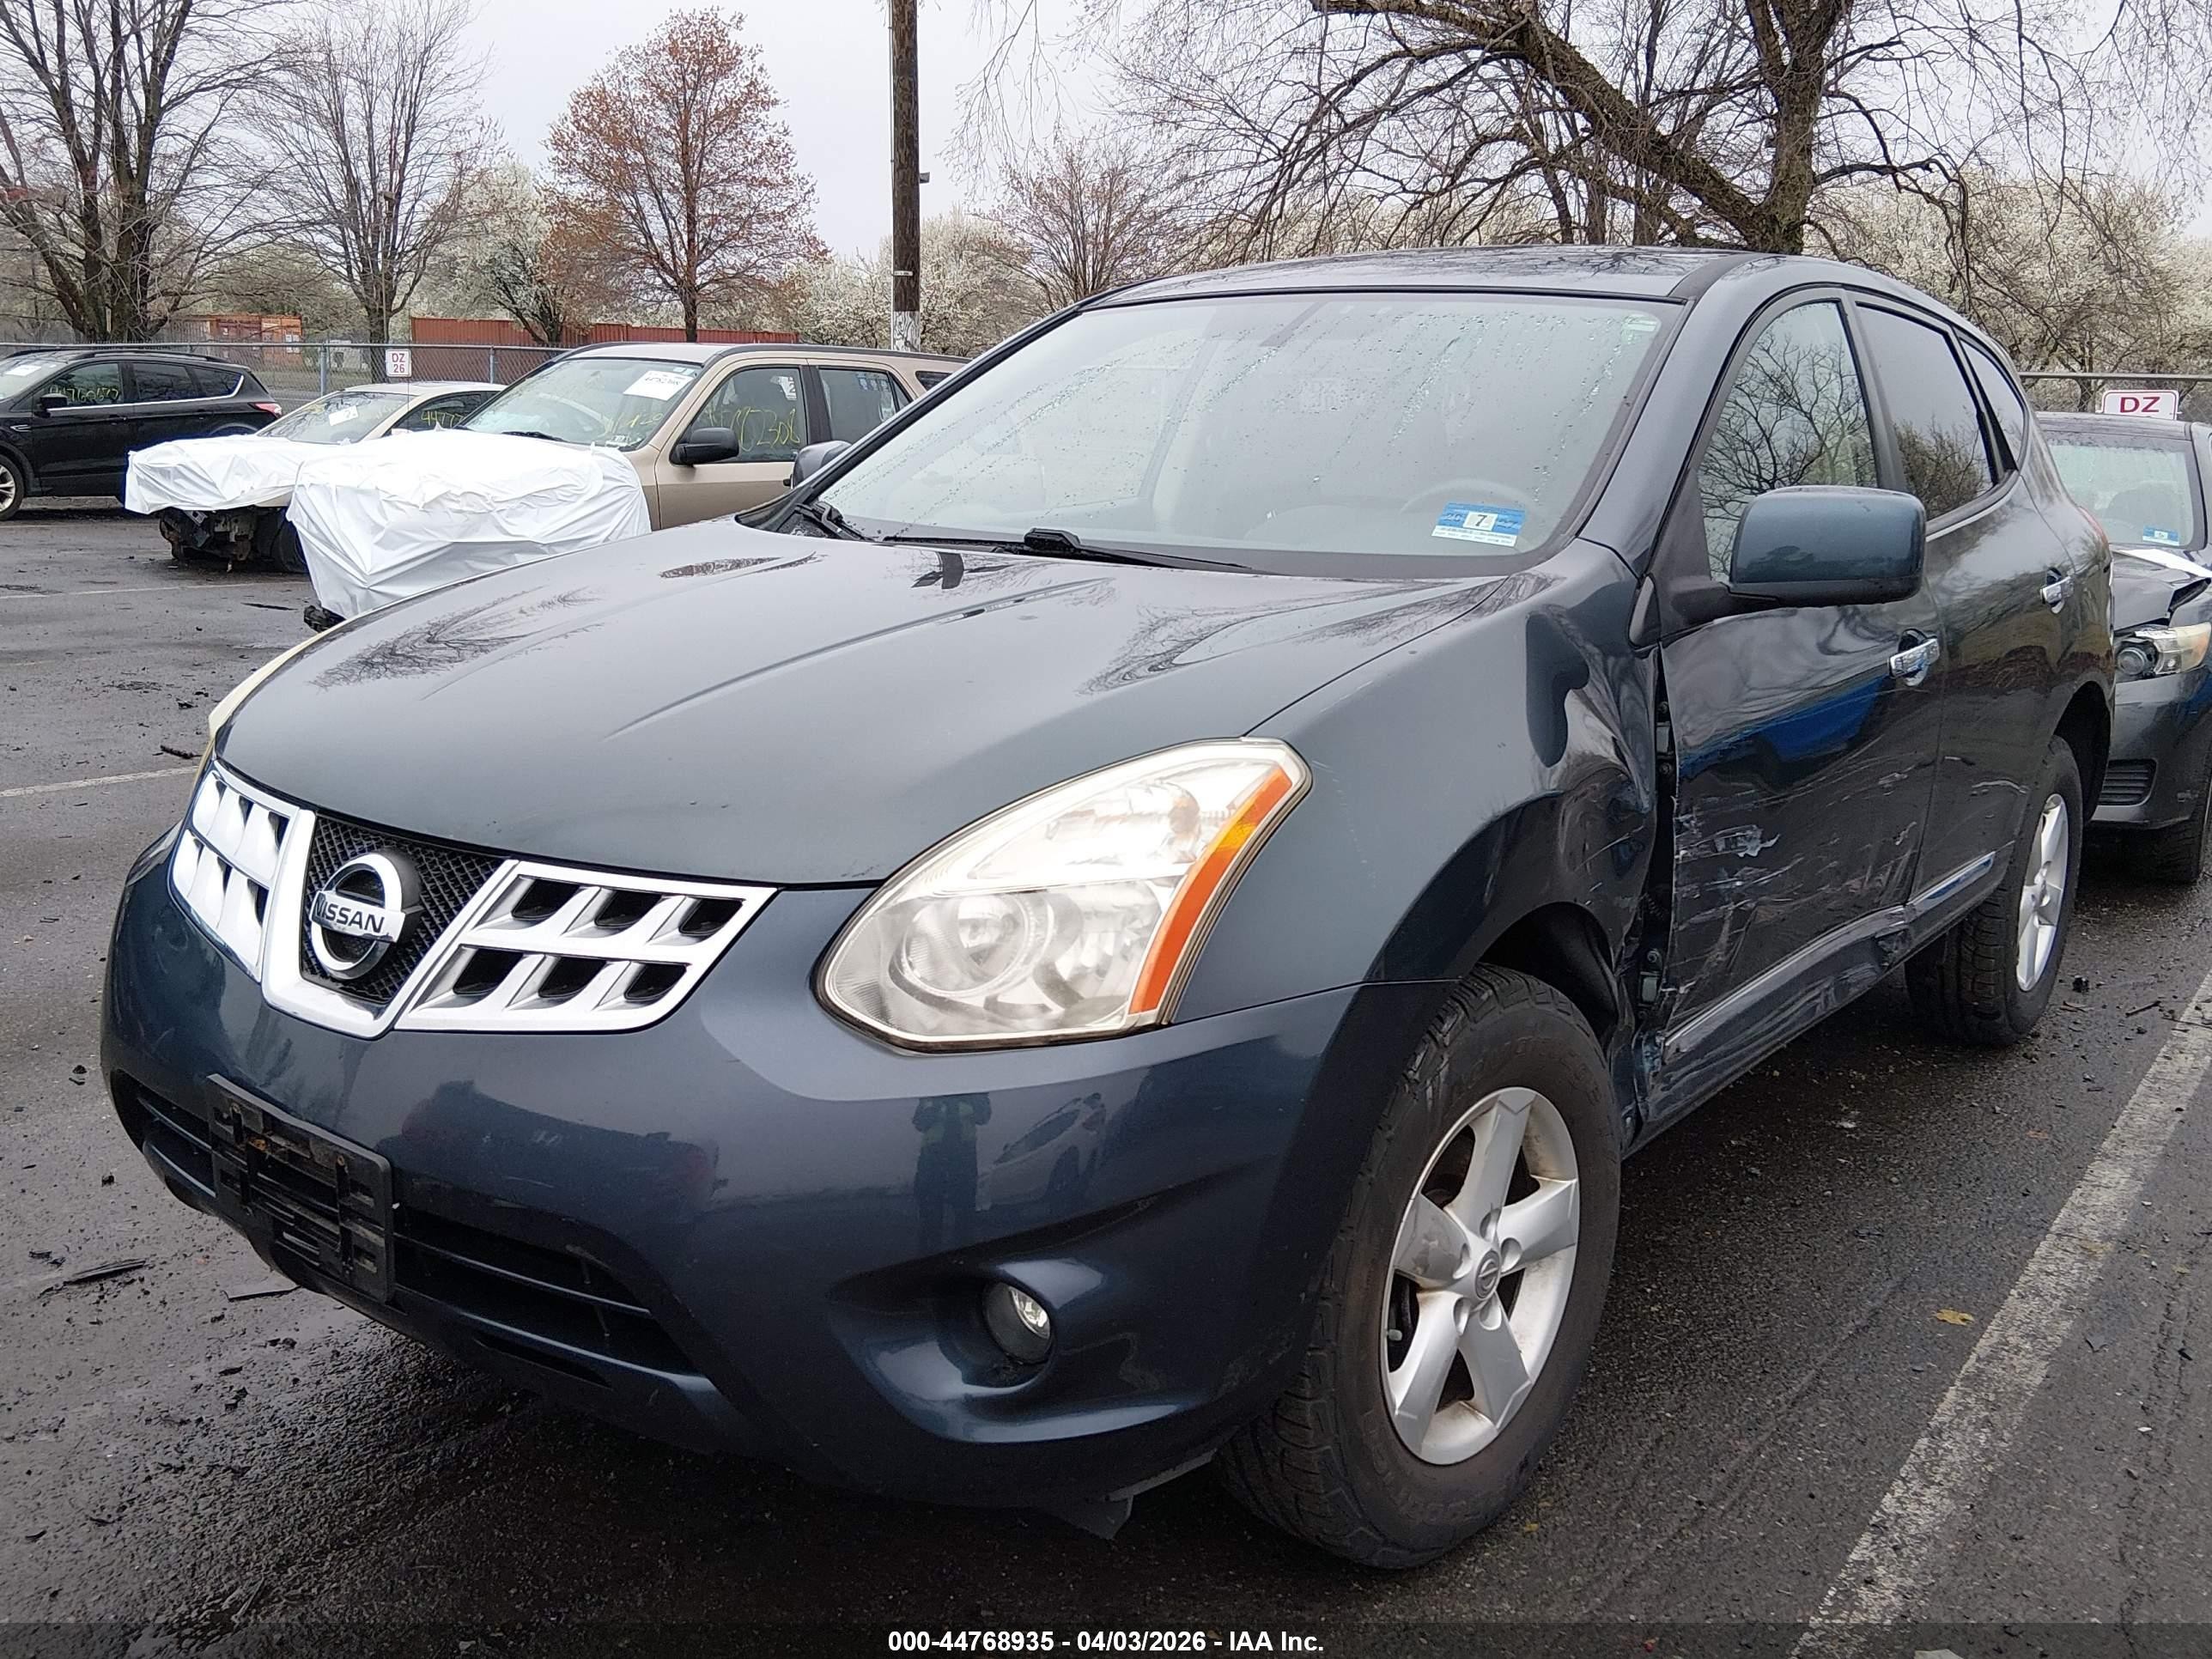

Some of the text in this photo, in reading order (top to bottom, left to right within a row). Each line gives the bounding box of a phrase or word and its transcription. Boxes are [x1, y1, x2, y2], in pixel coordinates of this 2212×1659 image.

[392, 353, 405, 363] DZ
[393, 363, 405, 374] 26
[2119, 396, 2161, 413] DZ
[1474, 514, 1488, 527] 7
[315, 892, 385, 934] NISSAN
